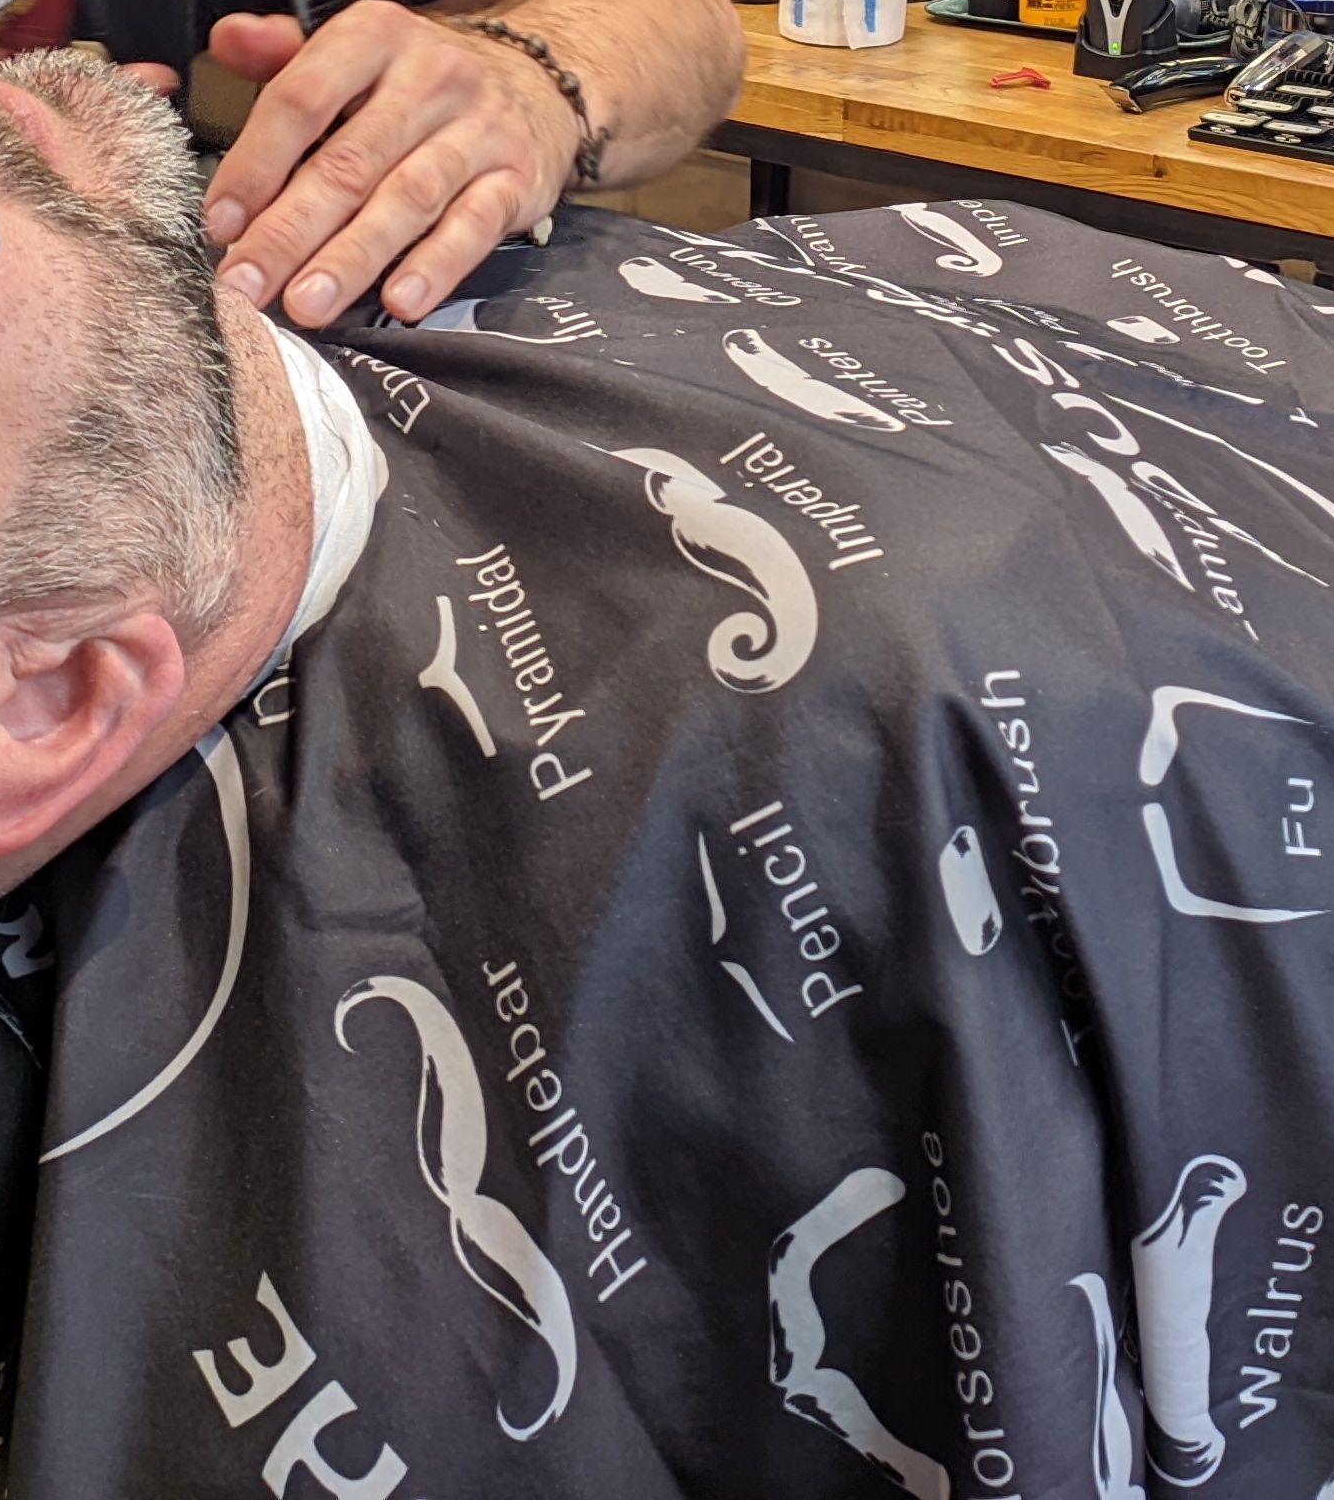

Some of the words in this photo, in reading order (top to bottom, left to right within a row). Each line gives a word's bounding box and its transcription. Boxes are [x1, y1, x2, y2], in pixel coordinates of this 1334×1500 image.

[797, 335, 953, 428] Painters
[1110, 257, 1287, 374] Toothbrush
[719, 431, 884, 570] Imperial
[455, 542, 593, 801] Pyramidal
[729, 800, 863, 1019] Pencil
[1284, 777, 1322, 858] Fu
[482, 958, 649, 1303] Handlebar
[919, 1130, 1023, 1500] orseshoe
[1239, 1202, 1324, 1430] Walrus
